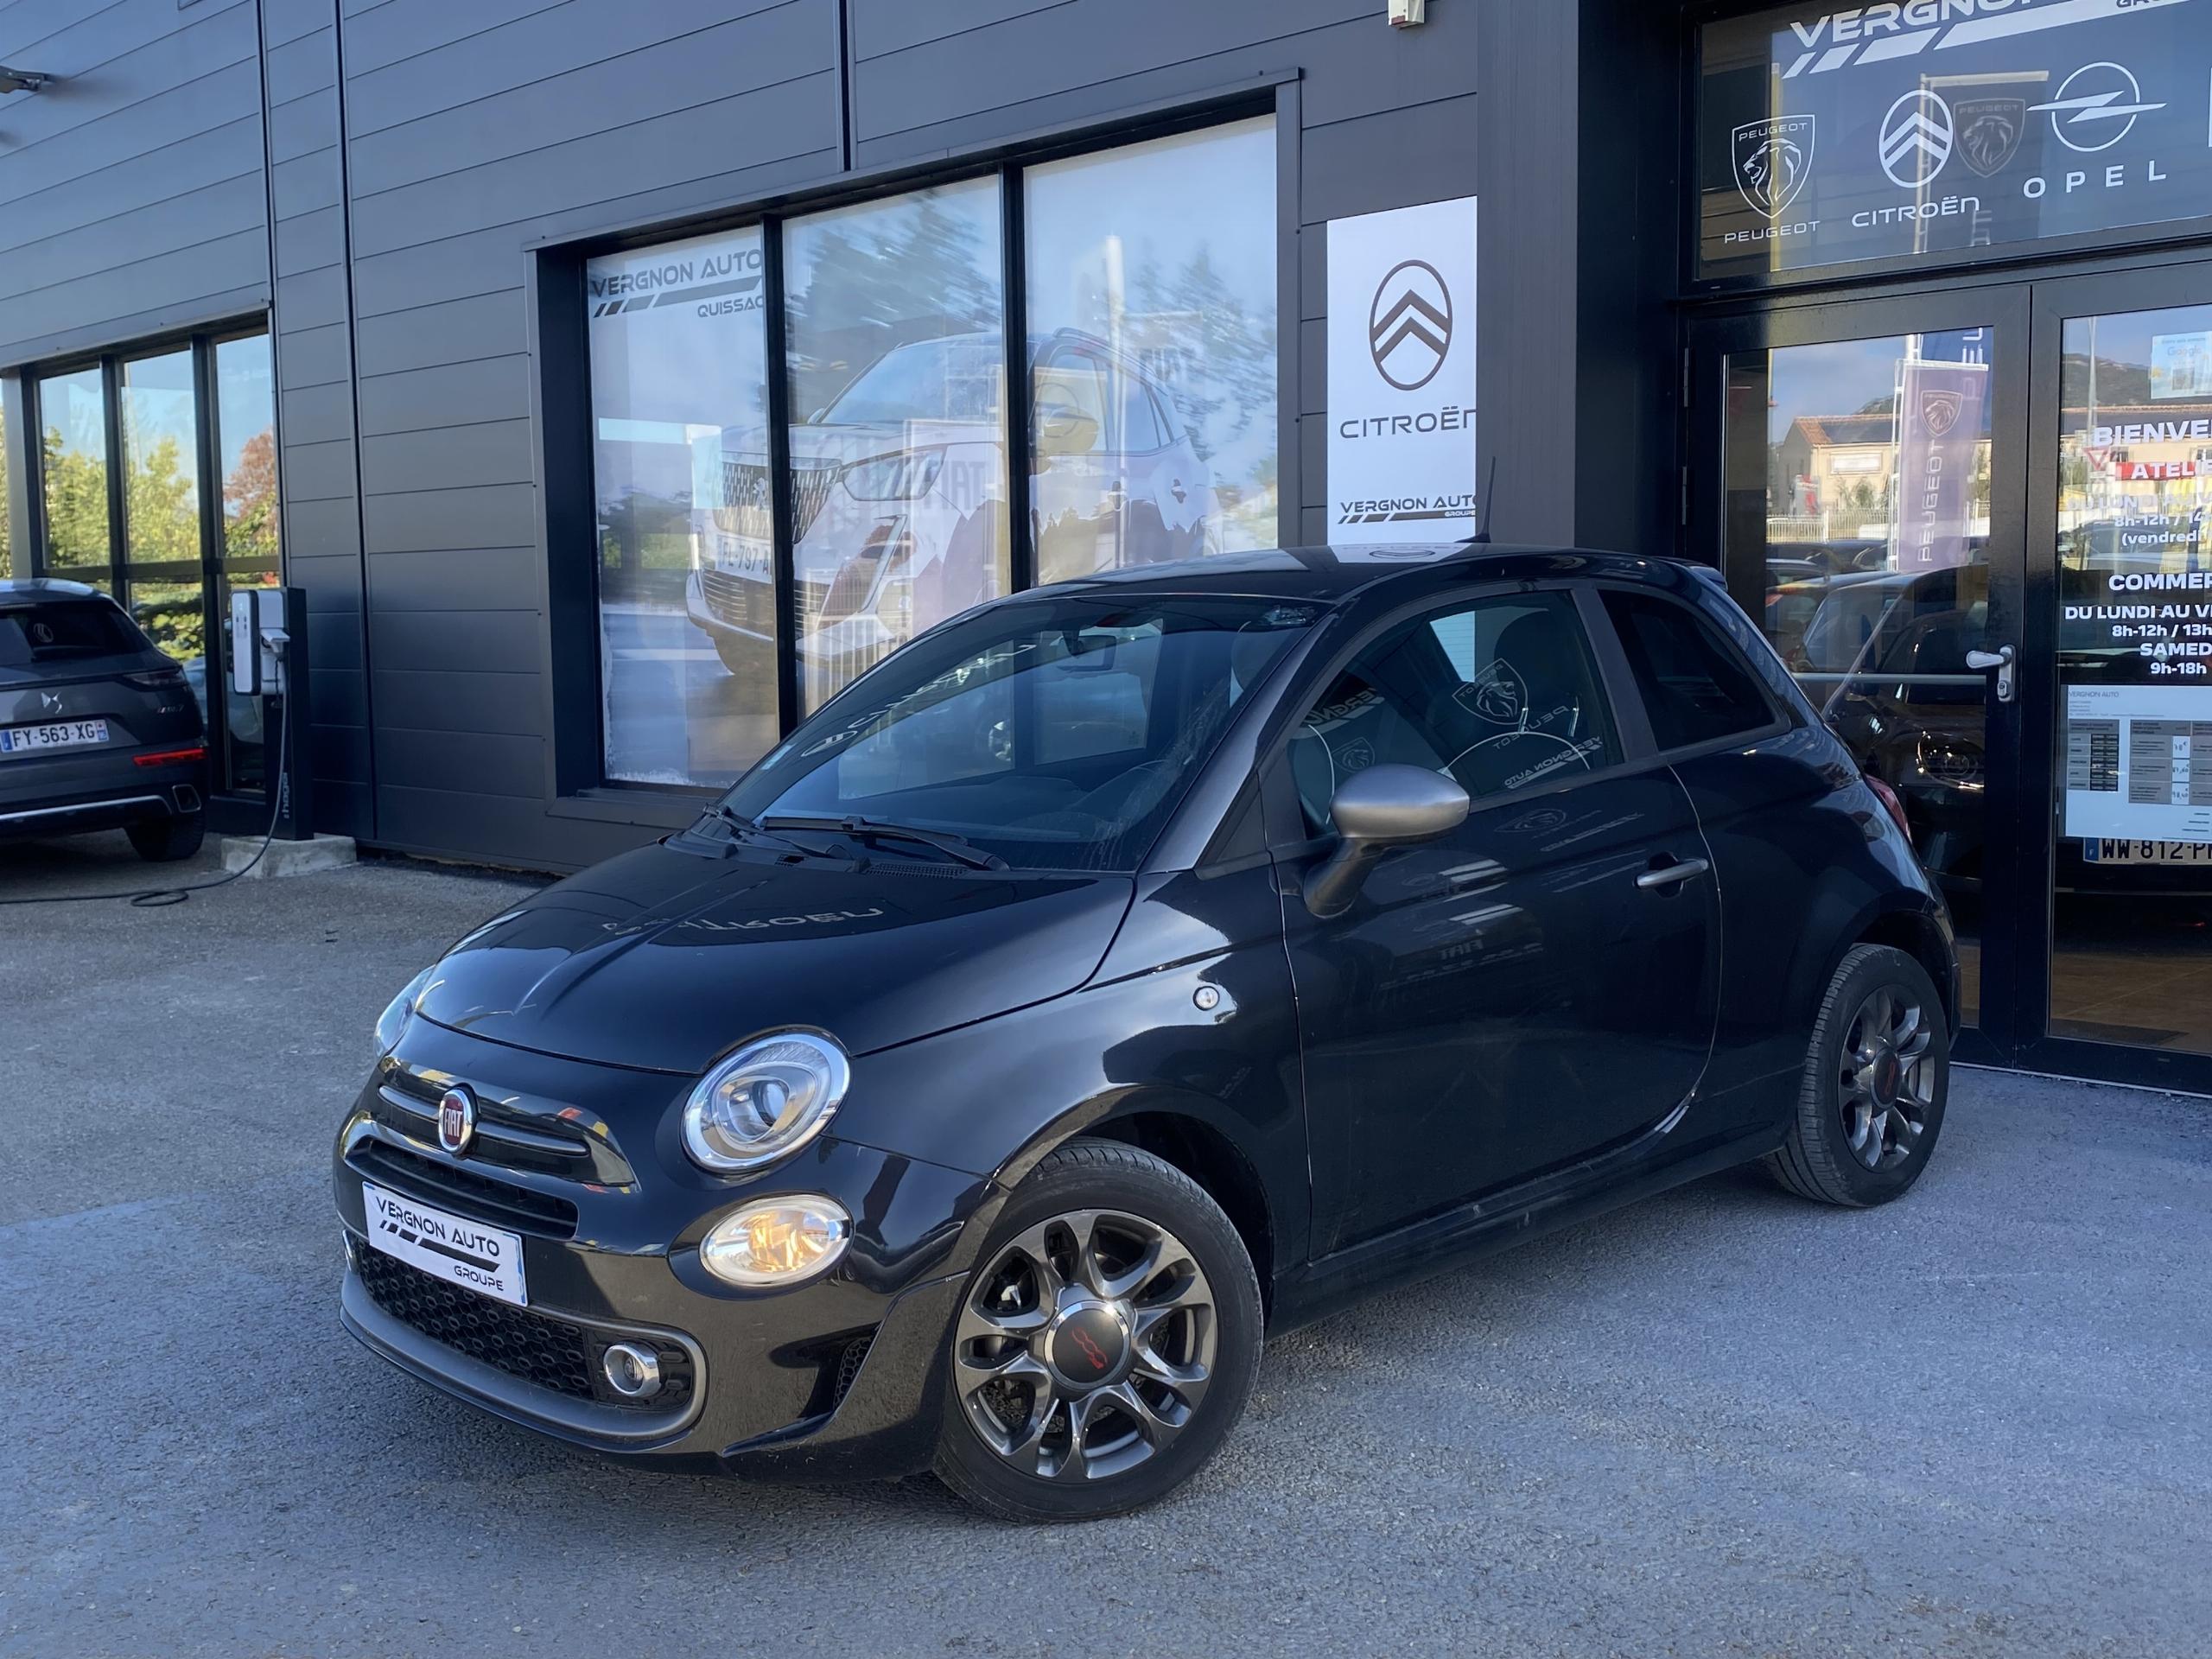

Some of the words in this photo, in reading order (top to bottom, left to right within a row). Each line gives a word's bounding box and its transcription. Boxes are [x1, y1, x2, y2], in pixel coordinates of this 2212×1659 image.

[1738, 122, 1808, 142] PEUGEOT
[2023, 160, 2167, 199] OPEL
[1724, 220, 1821, 244] PEUGEOT
[593, 261, 694, 297] VERGNON
[701, 248, 763, 279] AUTO
[2093, 419, 2212, 446] BIENVE
[1341, 498, 1427, 513] VERGNON
[1917, 439, 1944, 562] PEUGEOT
[2065, 606, 2092, 620] DU
[2097, 605, 2156, 619] LUNDI
[2161, 604, 2190, 619] AU
[2195, 604, 2212, 618] V
[2112, 624, 2168, 637] 8h-12h
[2171, 624, 2179, 638] /
[2150, 662, 2208, 675] 9h-18h
[13, 722, 96, 747] FY-563-XG
[444, 1108, 464, 1138] FIAT
[376, 1196, 446, 1239] VERGNON
[451, 1228, 499, 1257] AUTO
[454, 1265, 505, 1292] GROUPE
